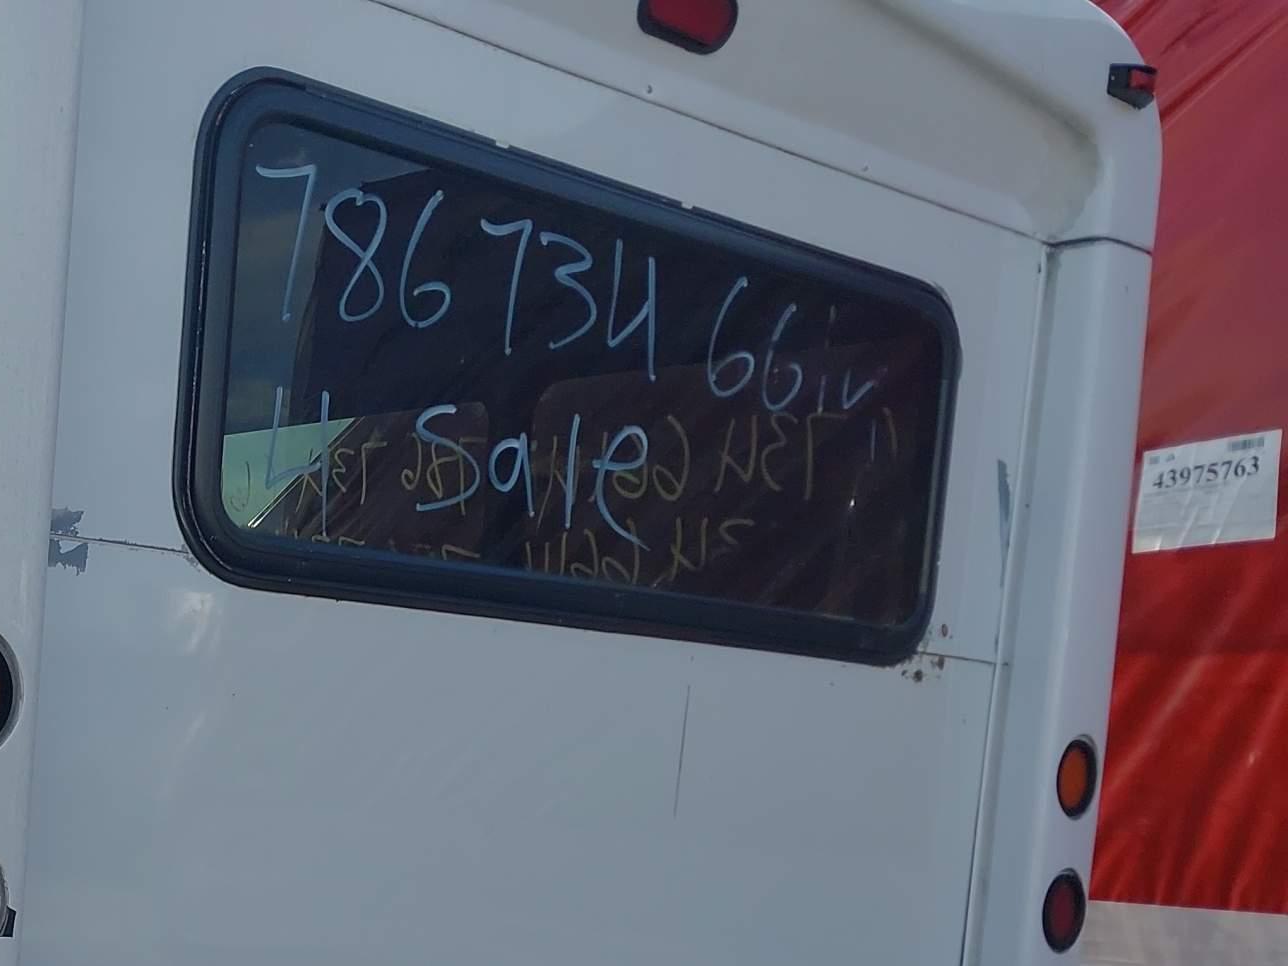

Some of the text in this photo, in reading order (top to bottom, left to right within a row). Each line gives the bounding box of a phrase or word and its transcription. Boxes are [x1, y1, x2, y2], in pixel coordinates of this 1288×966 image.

[255, 163, 453, 329] 786
[480, 217, 658, 382] 734
[415, 403, 651, 552] Sale
[1152, 455, 1260, 489] 43975763
